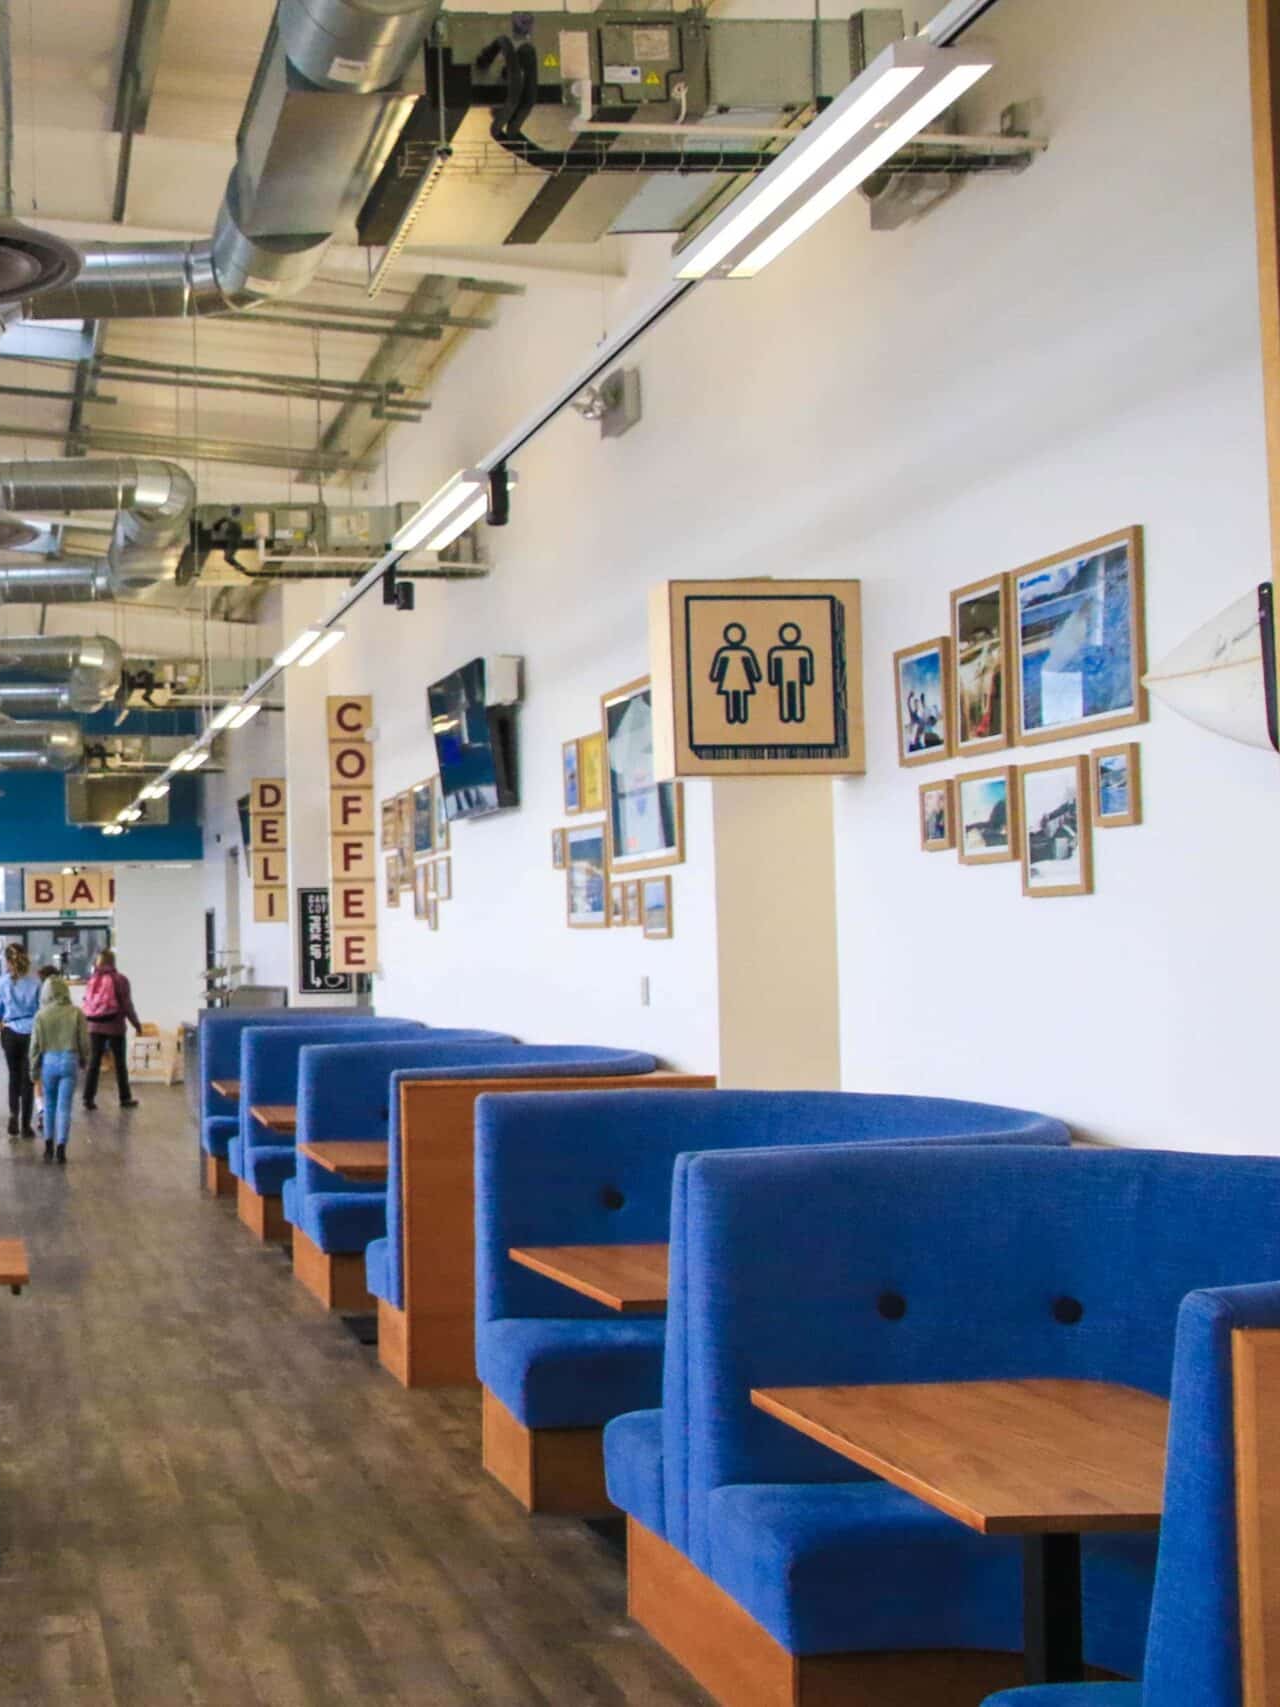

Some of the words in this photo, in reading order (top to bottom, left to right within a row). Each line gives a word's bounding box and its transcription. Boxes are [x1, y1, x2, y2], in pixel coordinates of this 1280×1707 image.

[260, 783, 282, 918] DELI
[335, 702, 366, 966] COFFEE
[308, 915, 322, 941] PICK
[309, 943, 322, 960] UP
